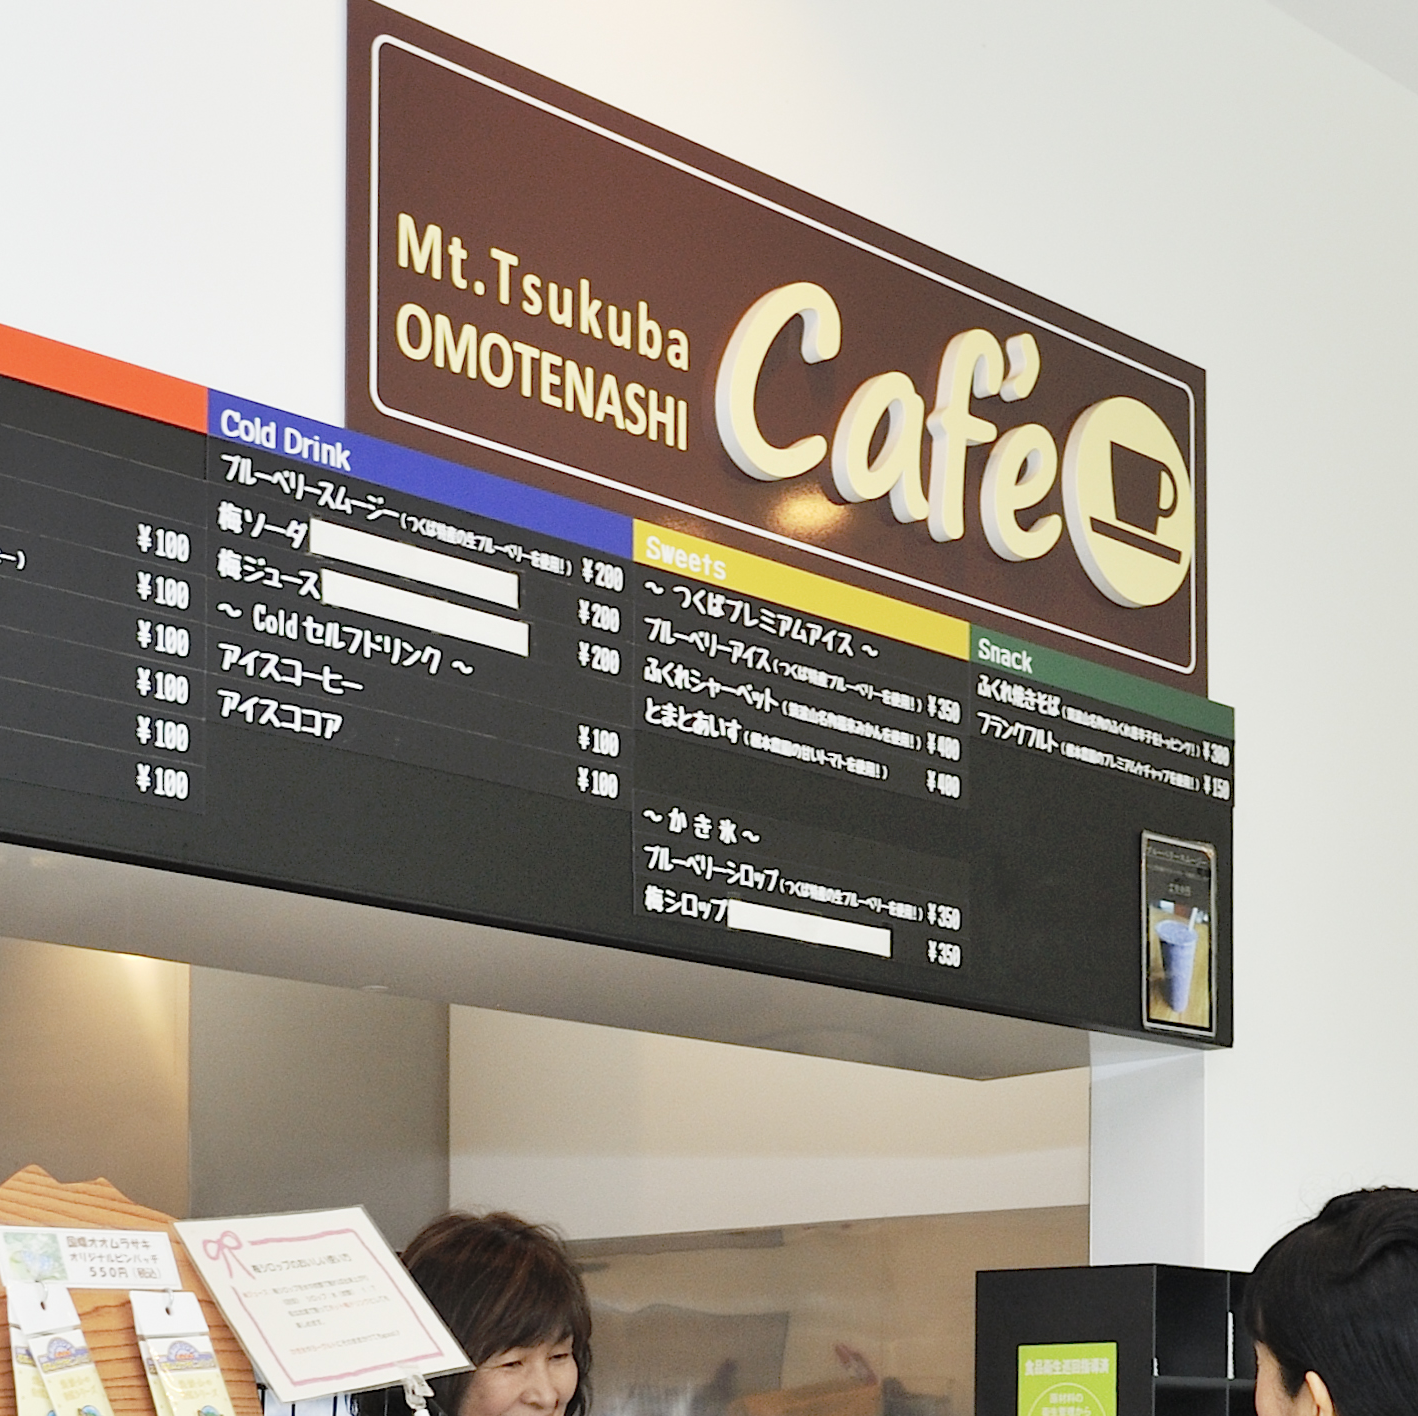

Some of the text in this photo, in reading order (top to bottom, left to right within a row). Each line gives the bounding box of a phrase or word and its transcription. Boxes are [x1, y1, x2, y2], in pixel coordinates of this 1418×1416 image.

[396, 213, 691, 373] Mt.Tsukuba
[395, 302, 689, 452] OMOTENASHI
[220, 409, 352, 472] Cold Drink
[136, 523, 190, 563] ¥100
[220, 452, 624, 593] ブルーベリースムージー ¥200
[217, 501, 621, 634] 梅ソーダ ¥200
[645, 535, 728, 581] Sweets
[136, 571, 190, 610] ¥100
[216, 546, 621, 676] 梅ジュース ¥200
[136, 619, 190, 657] ¥100
[252, 602, 299, 641] Cold
[302, 615, 442, 676] セルフドリンク
[672, 584, 856, 658] つくばプレミアムアイス
[643, 617, 772, 675] ブルーベリーアイス
[926, 693, 962, 725] ¥350
[977, 637, 1033, 675] Snack
[136, 667, 190, 705] ¥100
[216, 641, 620, 759] アイスコーヒー ¥100
[643, 655, 780, 714] ふくれシャーベット
[976, 673, 1062, 719] ふくれ焼きそば
[136, 715, 190, 752] ¥100
[216, 688, 620, 800] アイスココア ¥100
[643, 697, 744, 745] とまとあいす
[976, 711, 1060, 756] フランクフルト
[136, 763, 190, 800] ¥100
[643, 844, 780, 893] ブルーベリーシロップ
[643, 883, 728, 923] 梅シロップ
[89, 1266, 128, 1279] 550円
